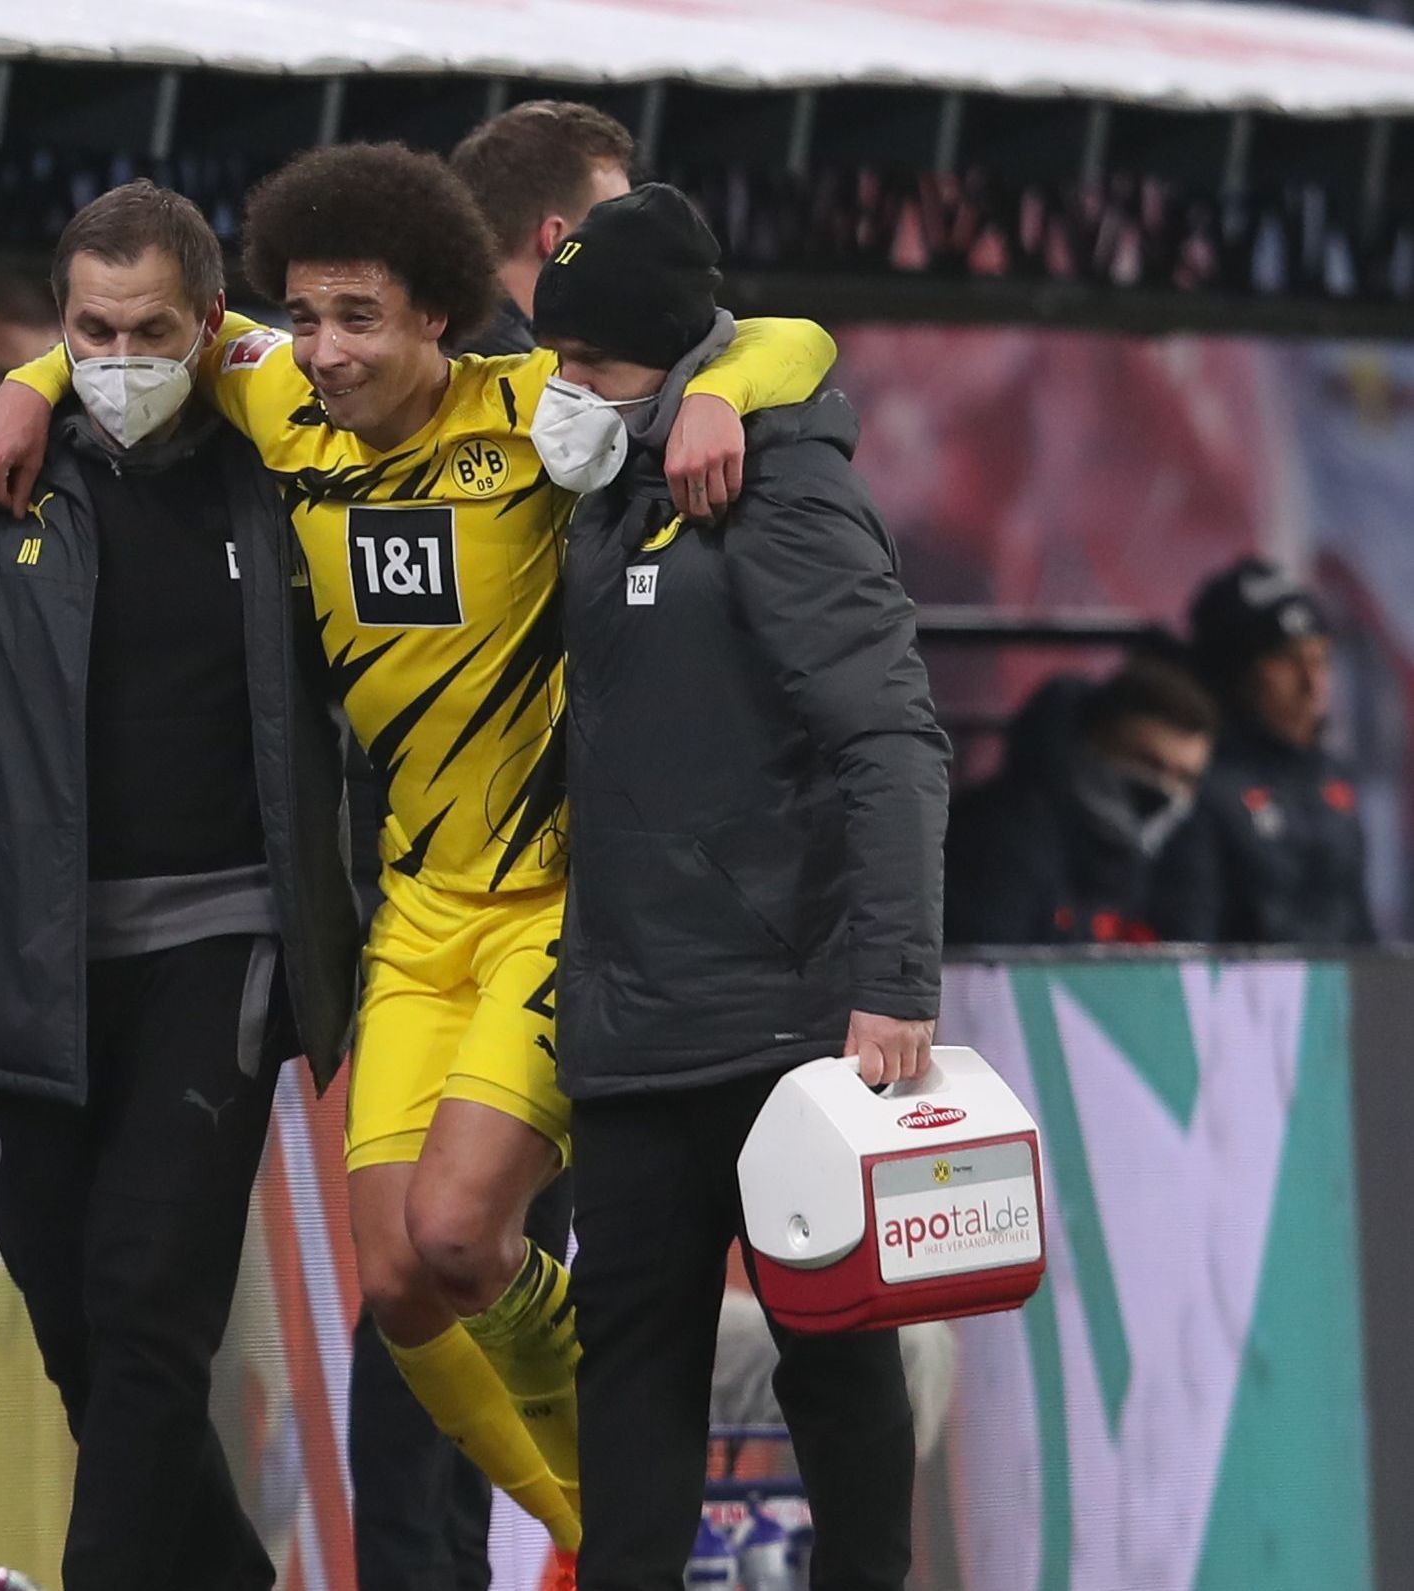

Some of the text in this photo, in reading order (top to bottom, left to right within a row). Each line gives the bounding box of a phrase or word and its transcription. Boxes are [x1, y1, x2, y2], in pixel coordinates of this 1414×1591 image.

[457, 441, 503, 484] BVB
[477, 476, 494, 491] 09
[16, 538, 42, 565] DH
[356, 536, 443, 595] 1&1
[630, 574, 654, 594] 1&1
[897, 1108, 966, 1131] playmate
[884, 1196, 1030, 1258] apotal.de
